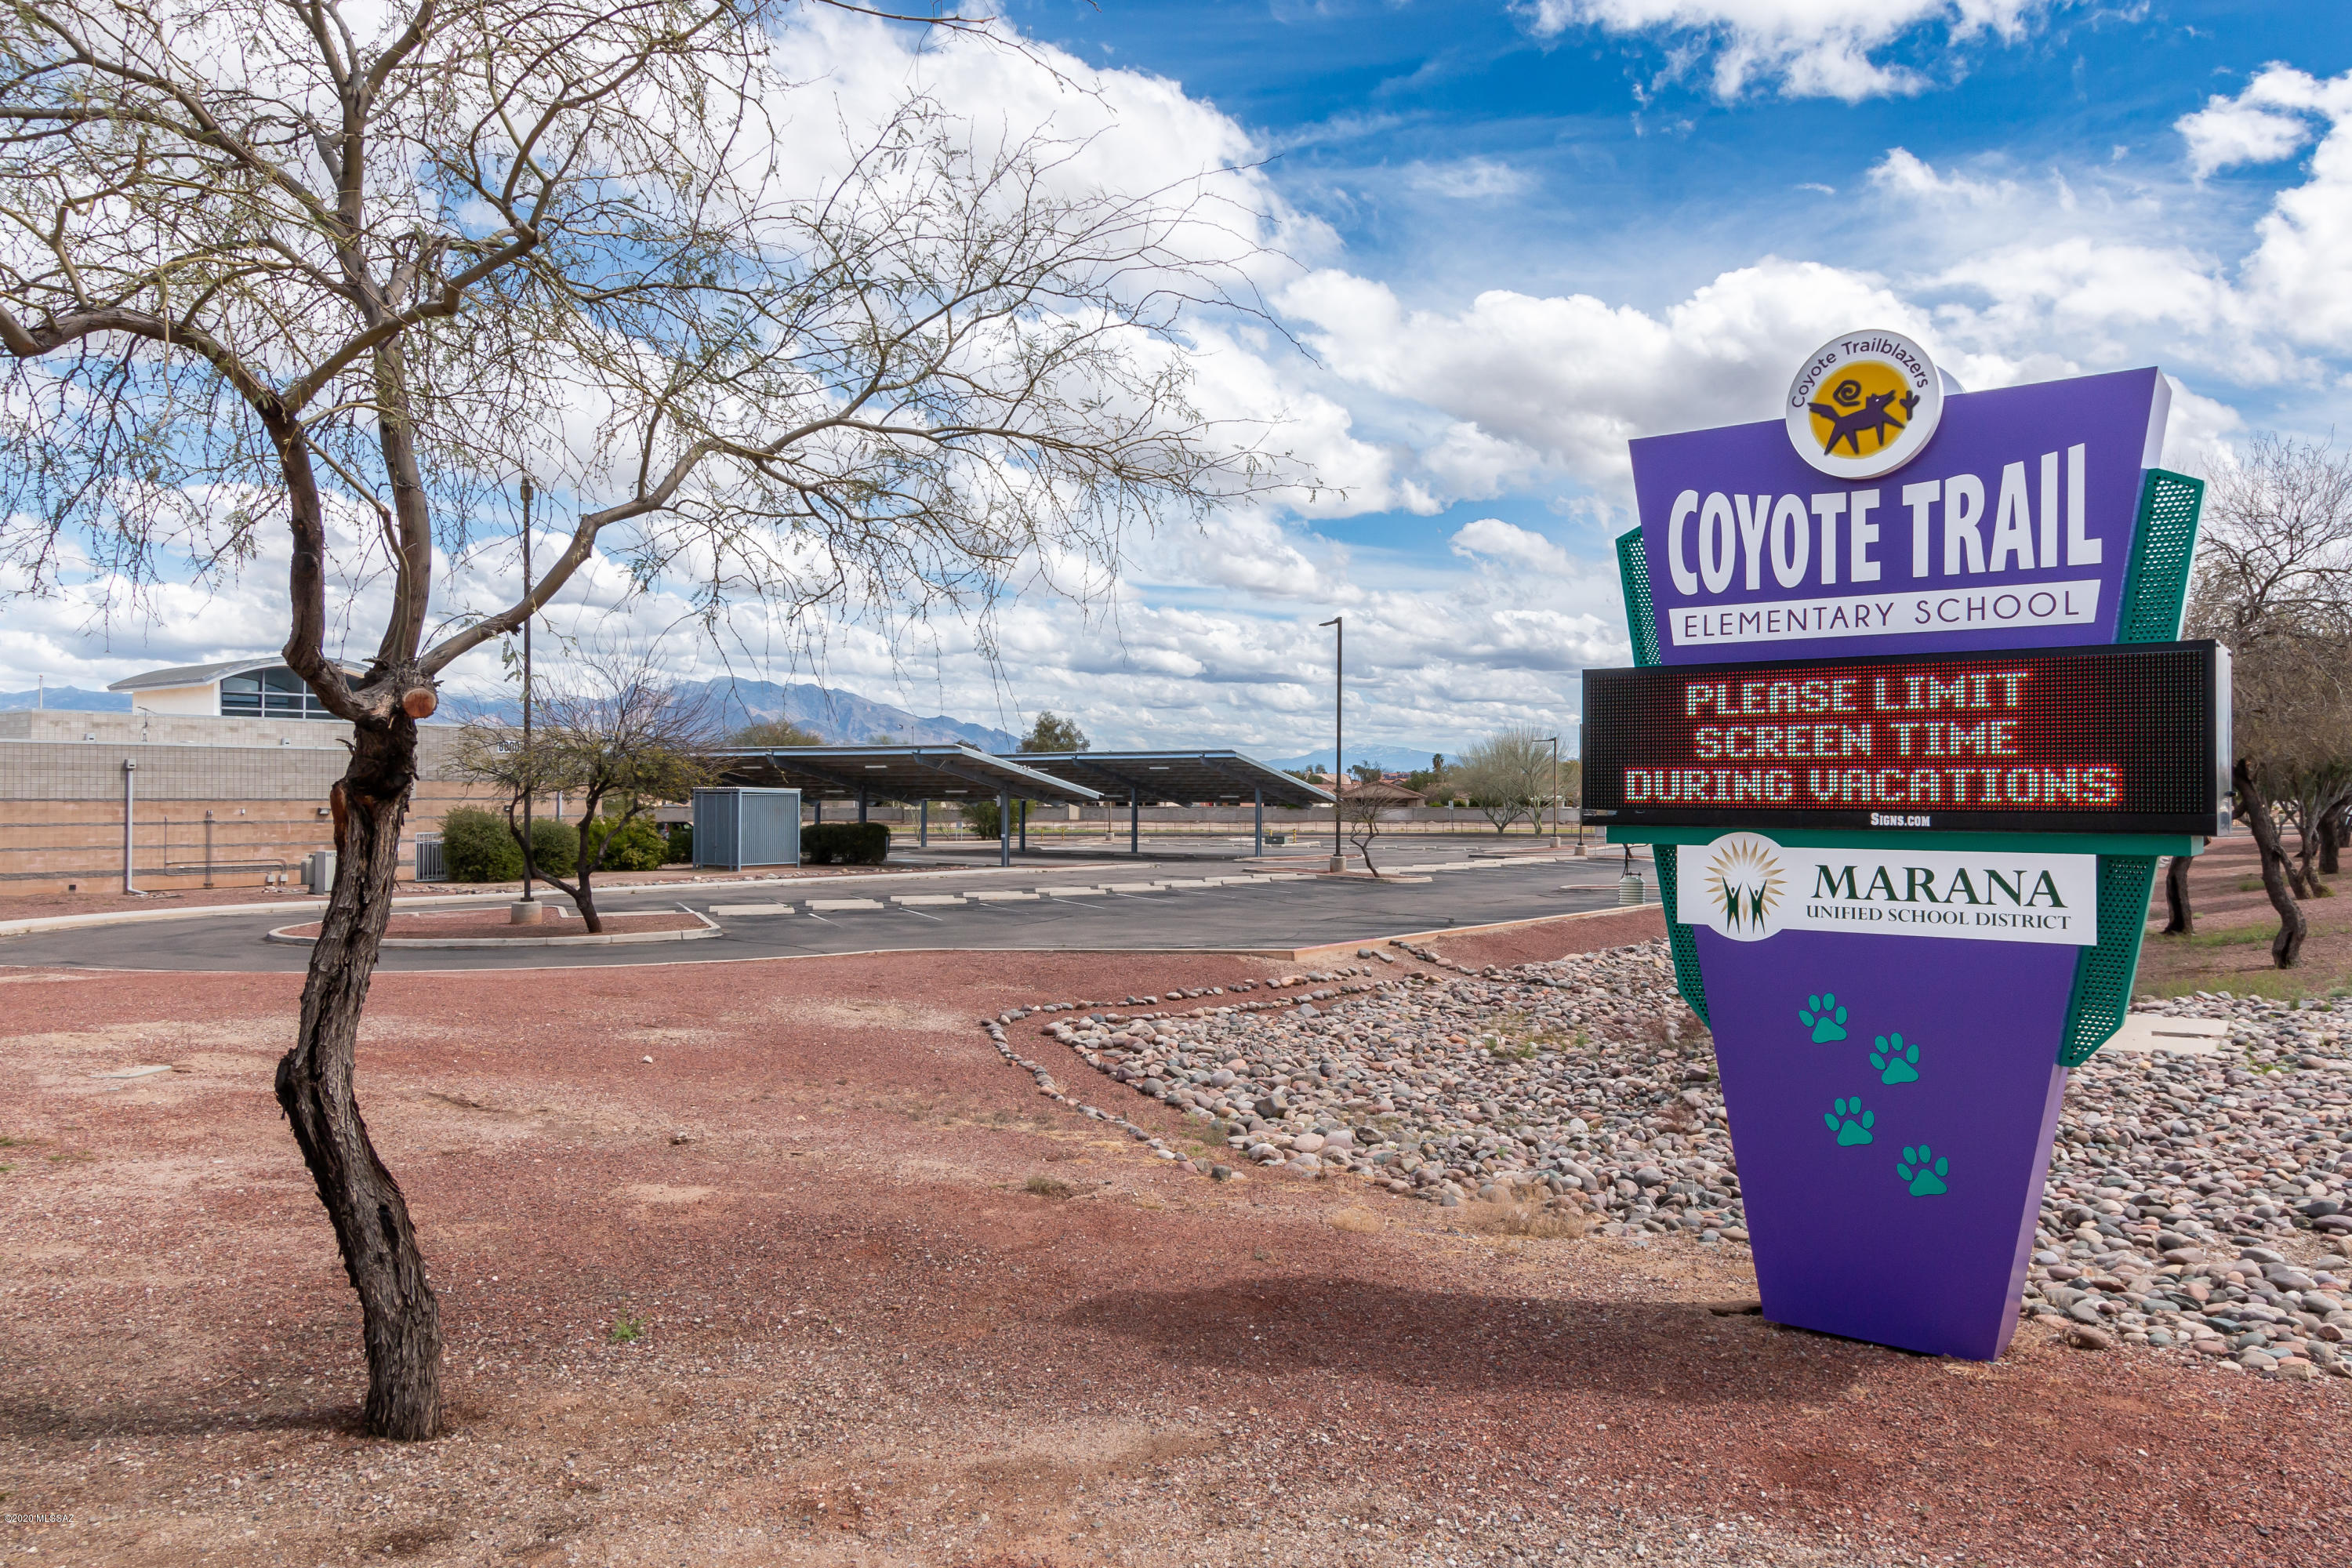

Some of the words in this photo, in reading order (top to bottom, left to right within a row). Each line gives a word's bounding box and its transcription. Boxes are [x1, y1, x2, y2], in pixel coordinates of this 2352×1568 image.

[1791, 353, 1837, 408] Coyote
[1841, 338, 1929, 388] Trailblazers
[1668, 488, 1882, 596] COYOTE
[1902, 442, 2103, 579] TRAIL
[1684, 602, 1895, 638] ELEMENTARY
[1915, 590, 2079, 625] SCHOOL
[1687, 679, 1858, 716] PLEASE
[1875, 672, 2029, 711] LIMIT
[1695, 723, 1872, 758] SCREEN
[1890, 720, 2018, 756] TIME
[1626, 770, 1793, 801] DURING
[1810, 767, 2117, 803] VACATIONS
[1809, 864, 2069, 909] MARANA
[1806, 904, 1882, 921] UNIFIED
[1888, 908, 1969, 926] SCHOOL
[1975, 912, 2072, 930] DISTRICT
